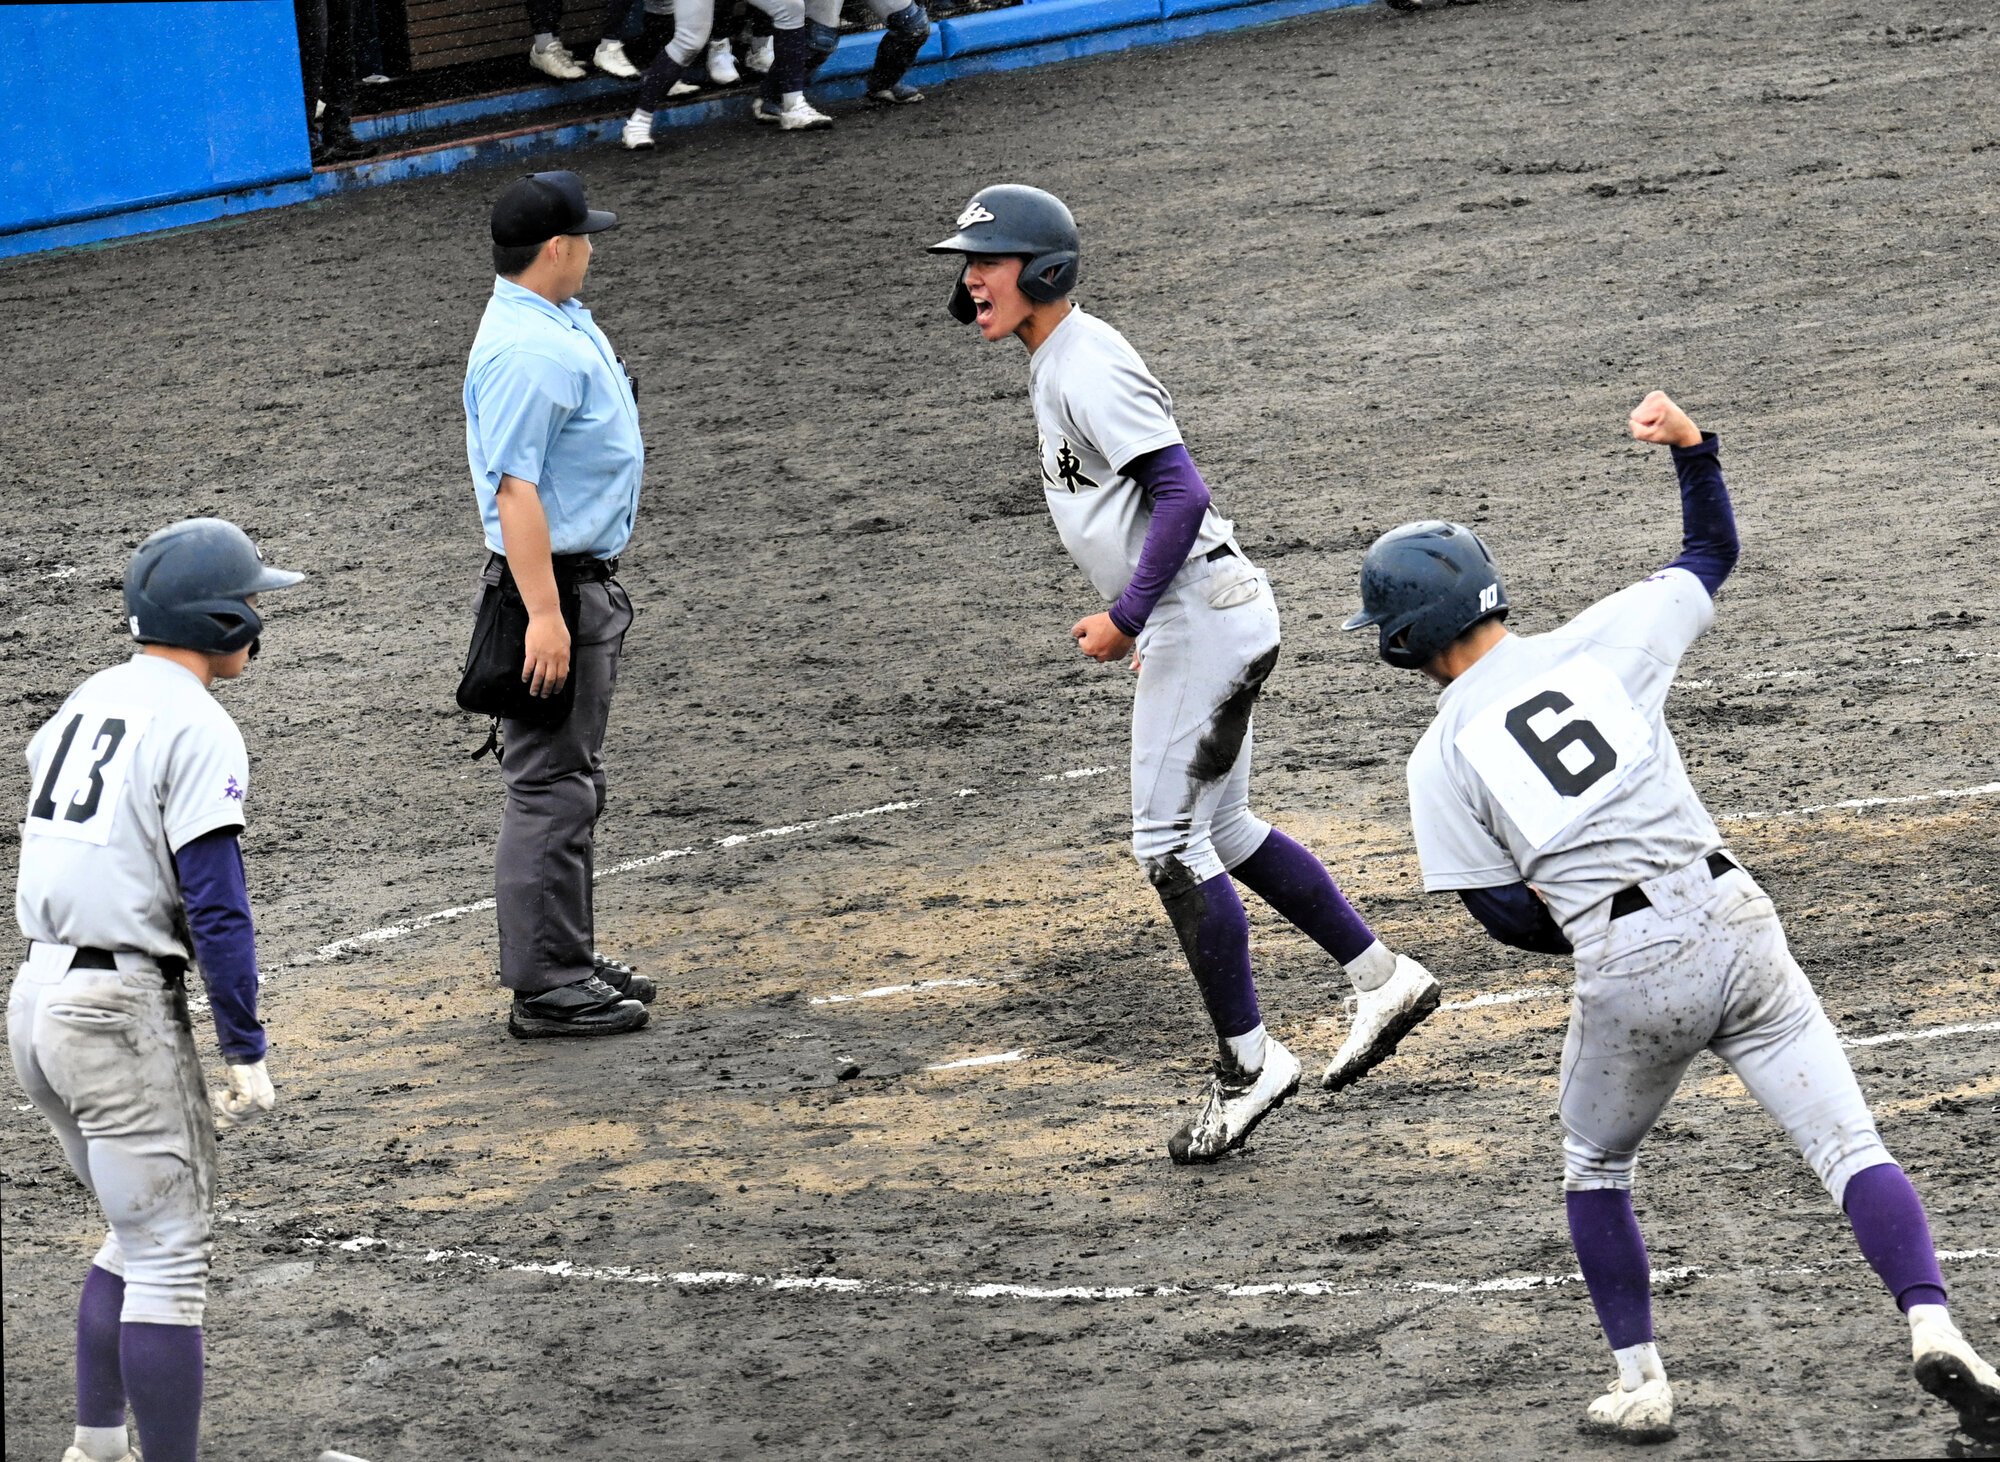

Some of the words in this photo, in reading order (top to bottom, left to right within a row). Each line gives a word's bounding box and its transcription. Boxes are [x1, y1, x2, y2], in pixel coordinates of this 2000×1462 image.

[1039, 437, 1100, 494] 東
[1478, 583, 1498, 613] 10
[30, 713, 127, 824] 13
[1504, 690, 1618, 797] 6
